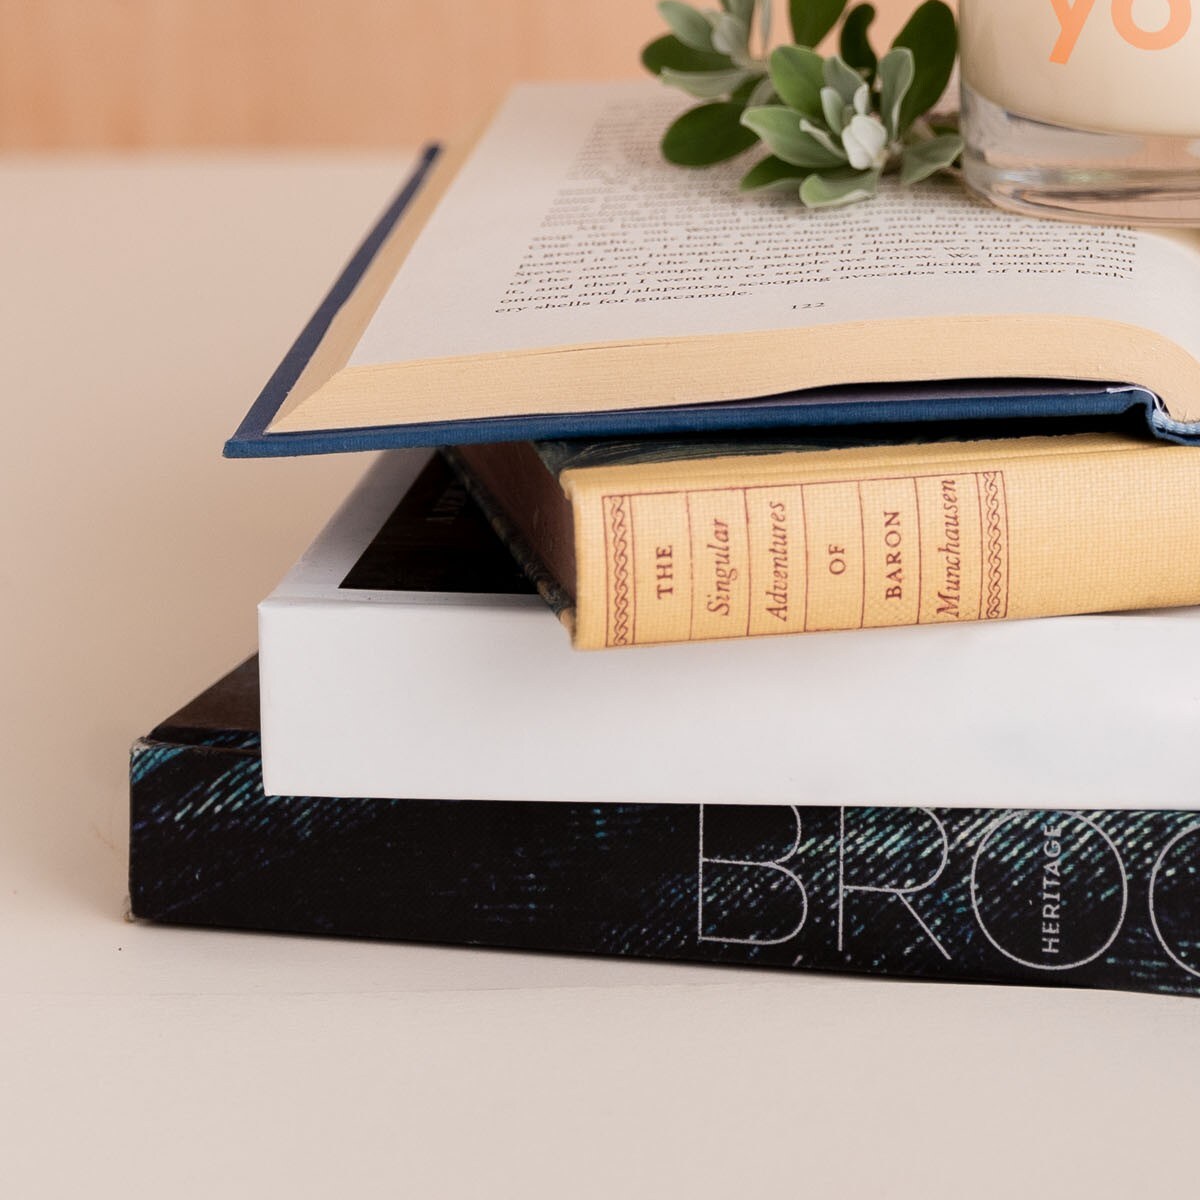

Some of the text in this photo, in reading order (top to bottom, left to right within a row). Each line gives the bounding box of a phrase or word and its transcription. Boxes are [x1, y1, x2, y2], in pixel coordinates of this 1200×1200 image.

[635, 264, 755, 276] competitive
[763, 259, 829, 269] people
[1077, 253, 1132, 264] about
[749, 249, 852, 261] basketball
[861, 246, 933, 255] players
[500, 295, 568, 303] onions
[578, 290, 616, 298] and
[738, 277, 830, 286] scooping
[839, 271, 935, 279] avocados
[1076, 269, 1135, 280] leath-
[536, 284, 574, 292] and
[833, 264, 905, 272] dinner,
[1096, 264, 1133, 272] and
[535, 301, 590, 309] shells
[635, 291, 753, 303] guacamole.
[791, 302, 825, 310] 122
[765, 502, 788, 622] Adventures
[829, 544, 846, 575] OF
[884, 511, 902, 601] BARON
[937, 480, 961, 618] Munchausen
[657, 544, 673, 600] THE
[707, 519, 736, 617] Singular
[1042, 824, 1062, 954] HERITAGE
